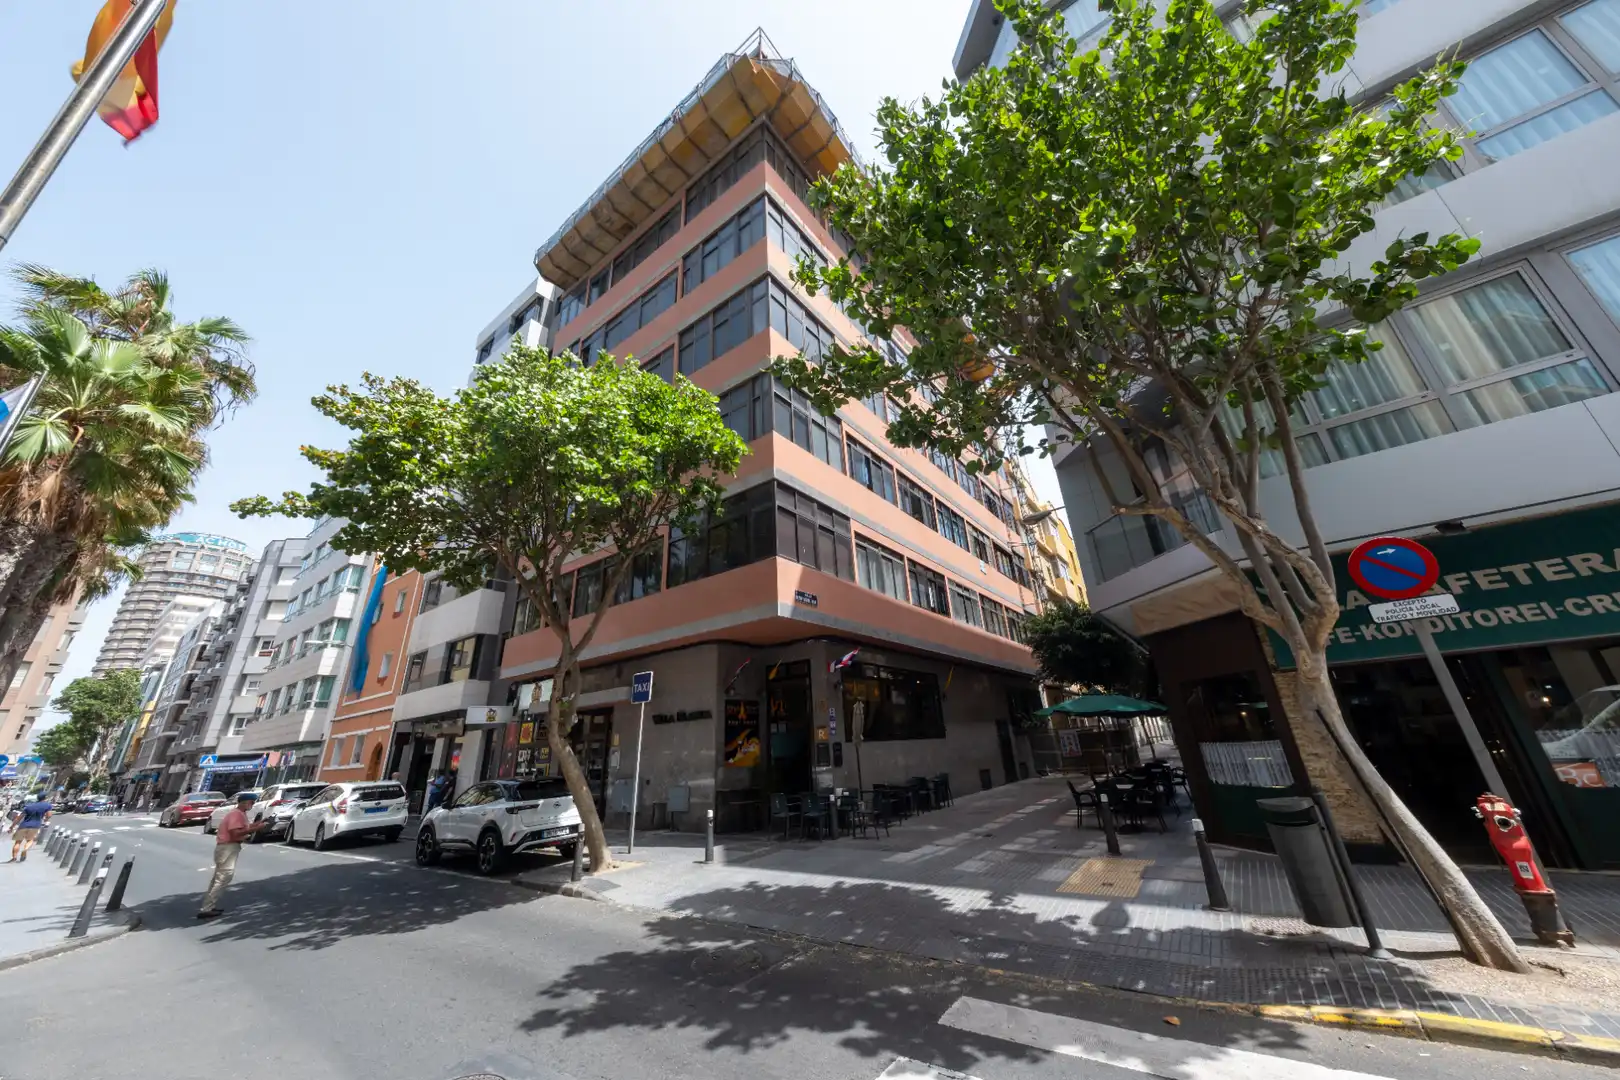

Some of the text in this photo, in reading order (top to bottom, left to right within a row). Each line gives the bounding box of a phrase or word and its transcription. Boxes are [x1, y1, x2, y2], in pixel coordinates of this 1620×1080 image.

[196, 536, 214, 544] AC
[1420, 548, 1620, 597] AFETER
[1393, 598, 1427, 607] EXCEPTO
[1415, 603, 1441, 611] LOCAL
[1416, 606, 1457, 616] MOVILIDAD
[634, 682, 650, 694] TAXI
